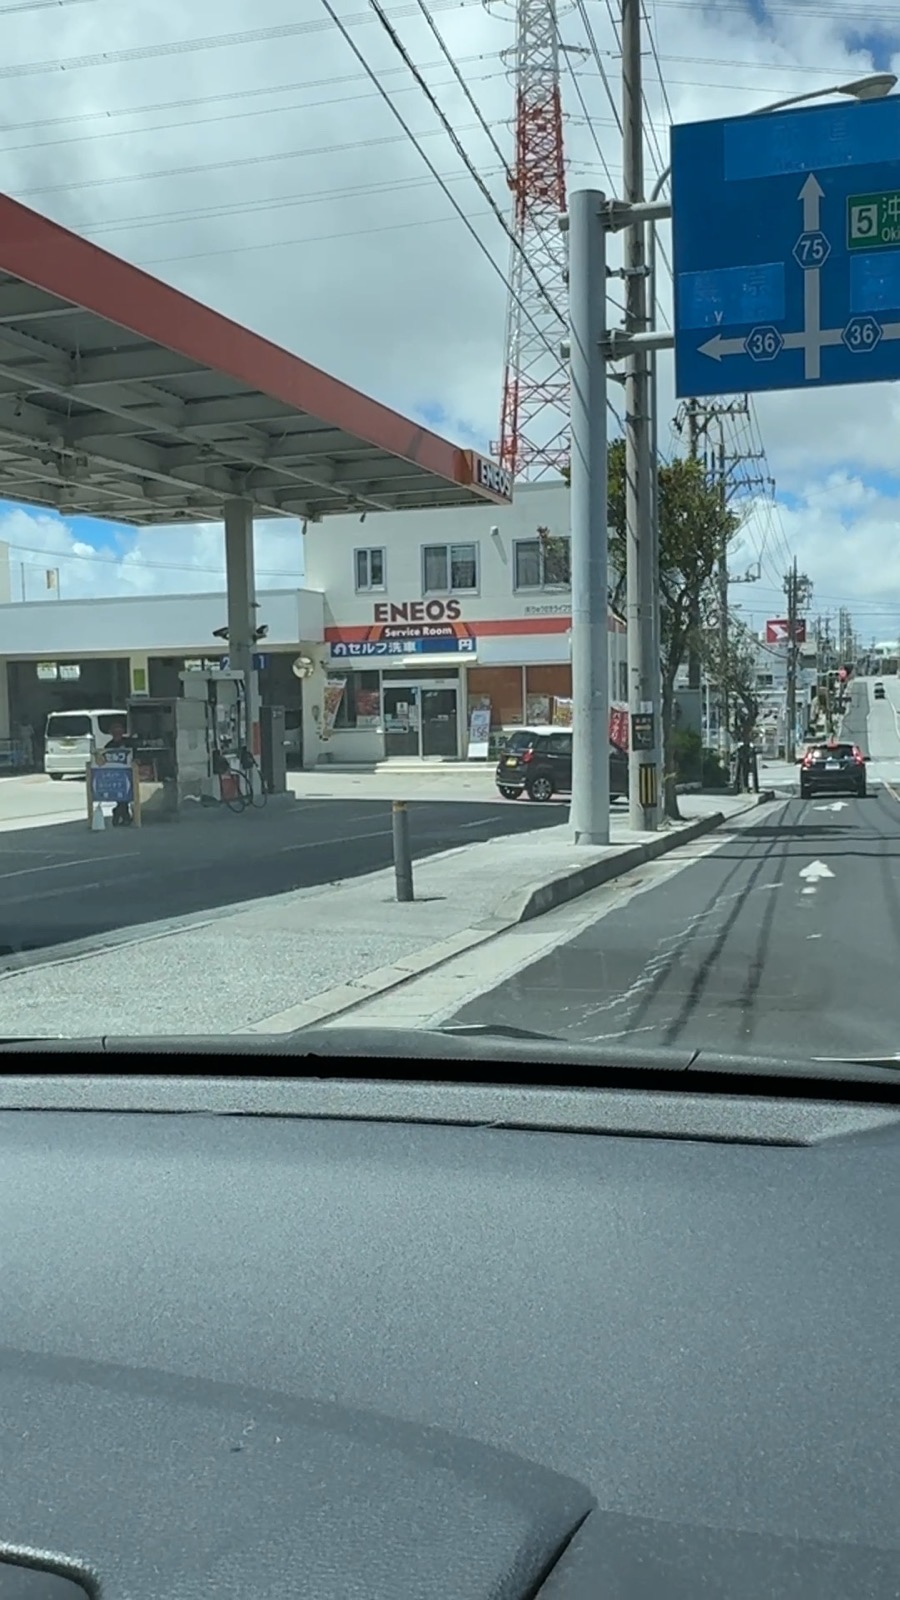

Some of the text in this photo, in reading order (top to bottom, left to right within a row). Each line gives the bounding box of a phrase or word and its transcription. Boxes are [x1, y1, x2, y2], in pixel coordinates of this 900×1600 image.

[857, 207, 874, 235] 5
[800, 239, 824, 260] 75
[752, 333, 775, 354] 36
[850, 323, 874, 344] 36
[481, 463, 511, 497] ENEOS
[374, 599, 462, 623] ENEOS
[384, 626, 453, 638] Service Room
[348, 638, 473, 655] セルフ洗車 円
[222, 656, 231, 671] 2
[258, 655, 265, 669] 1
